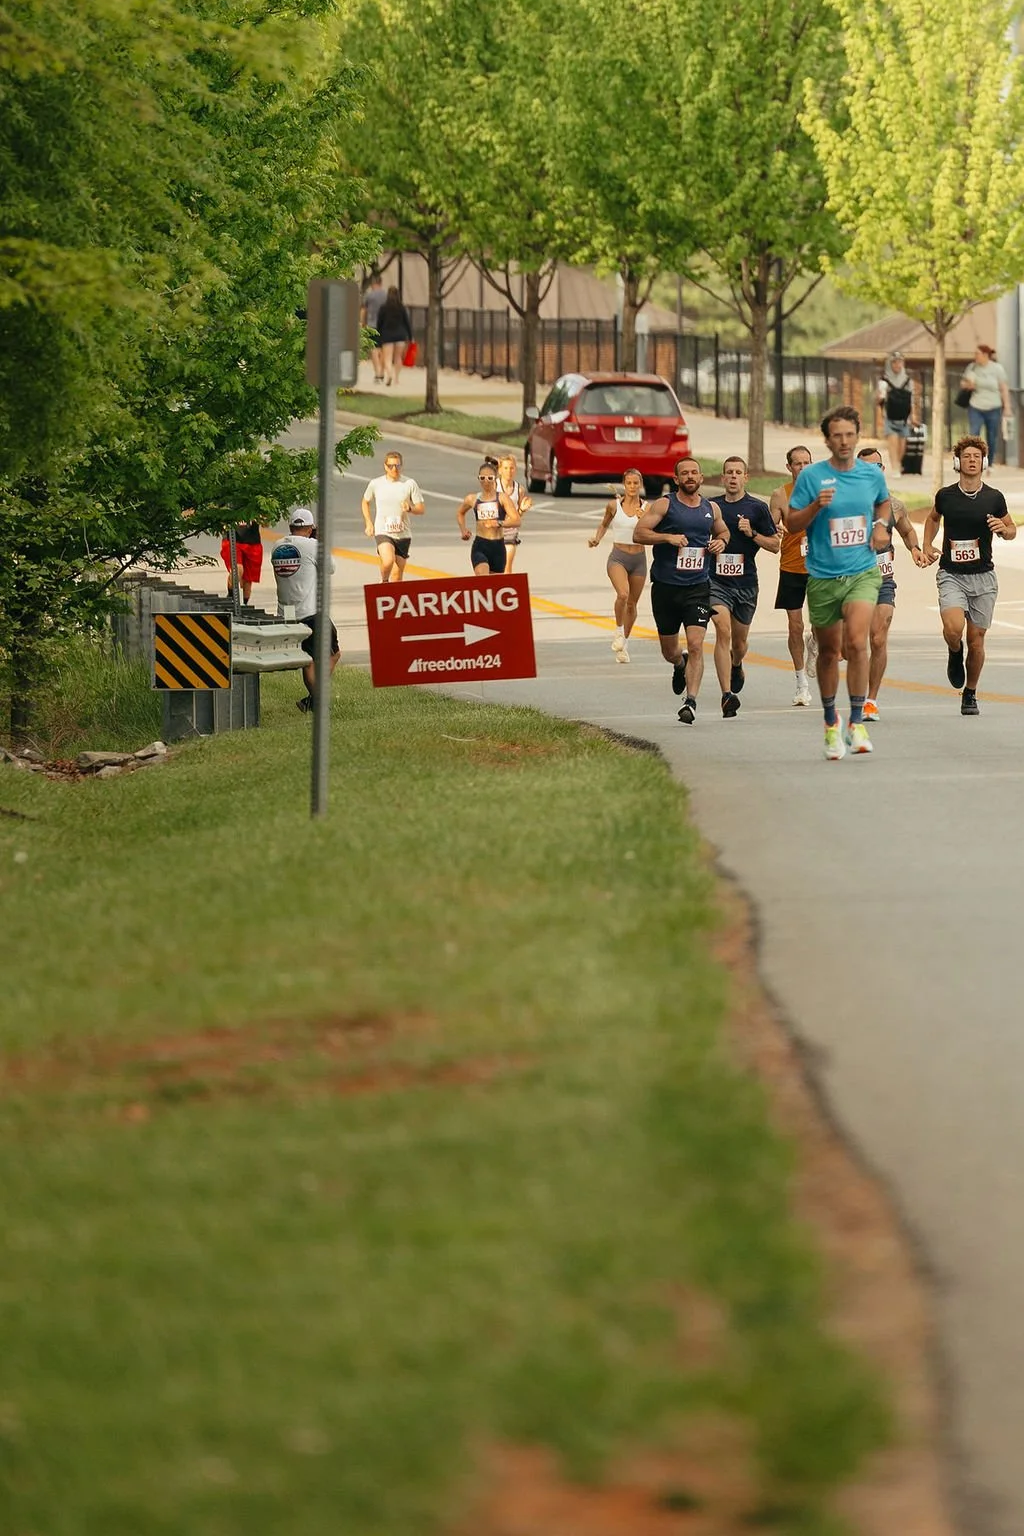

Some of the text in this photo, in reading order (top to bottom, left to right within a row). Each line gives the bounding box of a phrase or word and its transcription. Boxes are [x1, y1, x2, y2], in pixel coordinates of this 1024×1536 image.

[833, 529, 864, 544] 1979
[956, 549, 975, 560] 563
[679, 557, 702, 569] 1814
[718, 563, 742, 574] 1892
[879, 562, 893, 575] 06
[376, 587, 519, 620] PARKING
[417, 654, 501, 672] freedom424
